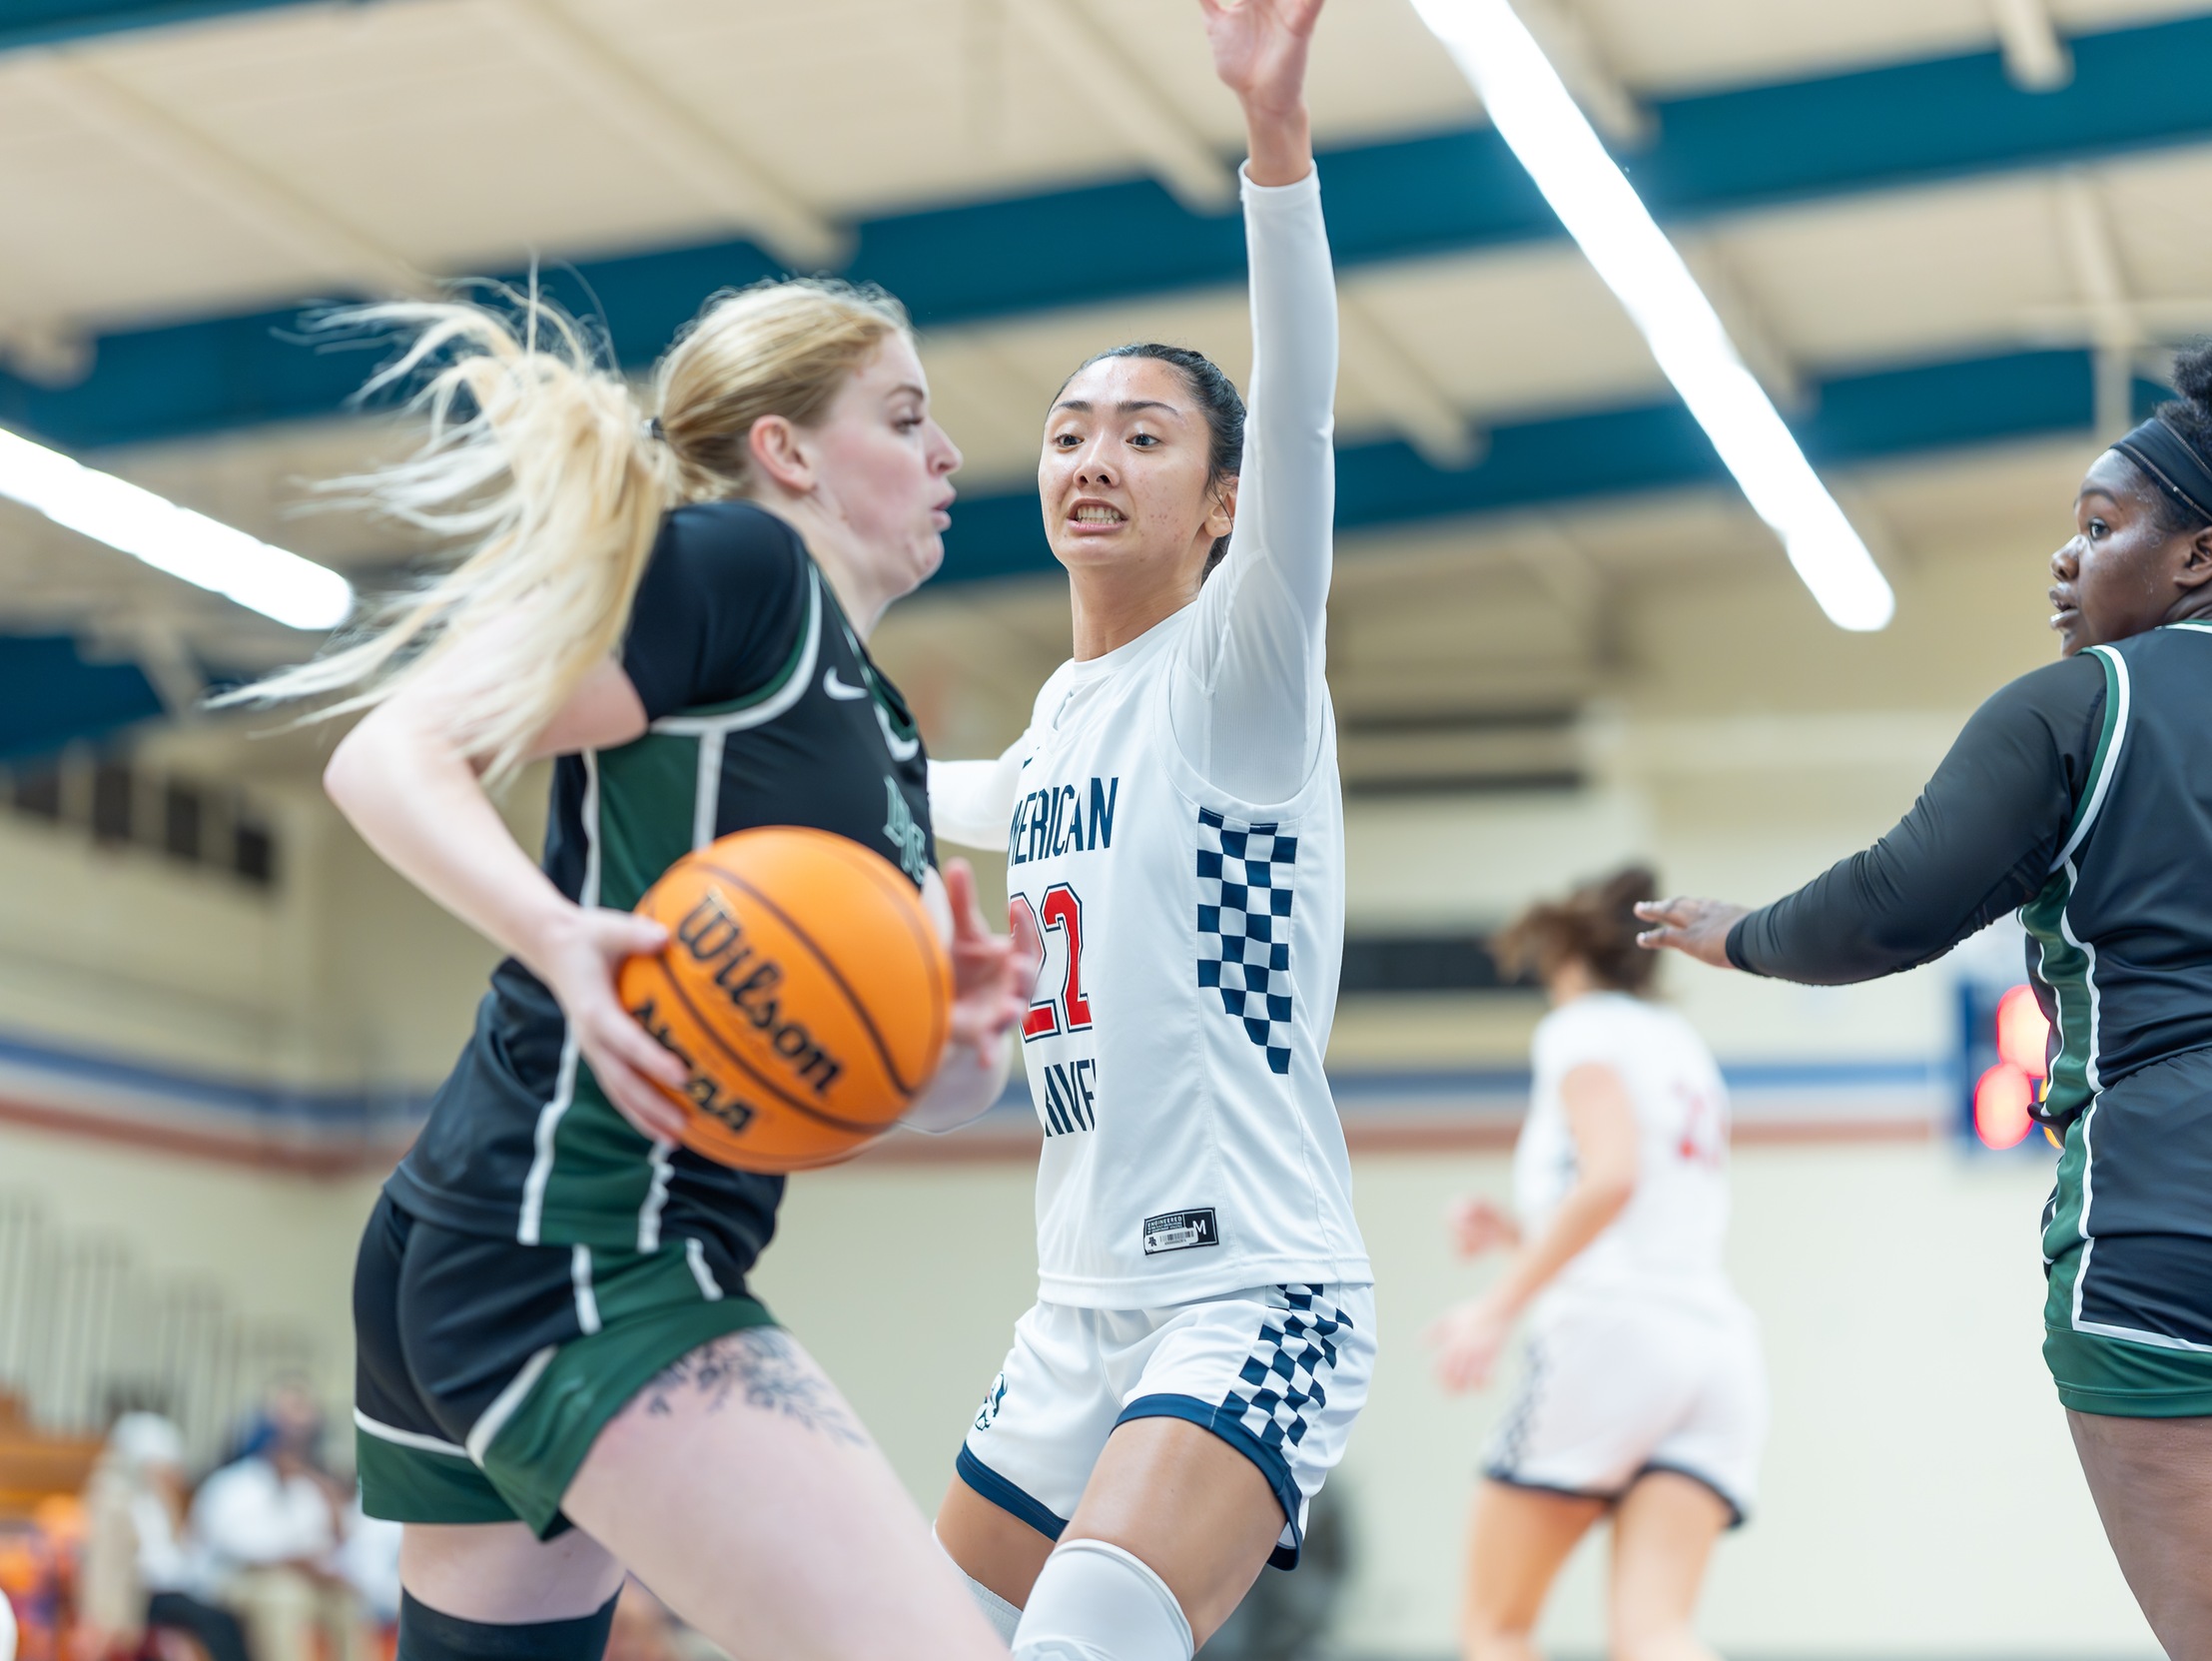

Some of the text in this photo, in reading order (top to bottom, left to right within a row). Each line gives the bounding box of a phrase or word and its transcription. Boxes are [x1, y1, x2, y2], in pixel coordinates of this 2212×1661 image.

[1008, 777, 1118, 867] MERICAN
[676, 889, 844, 1096] Wilson
[1044, 1059, 1097, 1138] IVE
[1192, 1220, 1206, 1236] M
